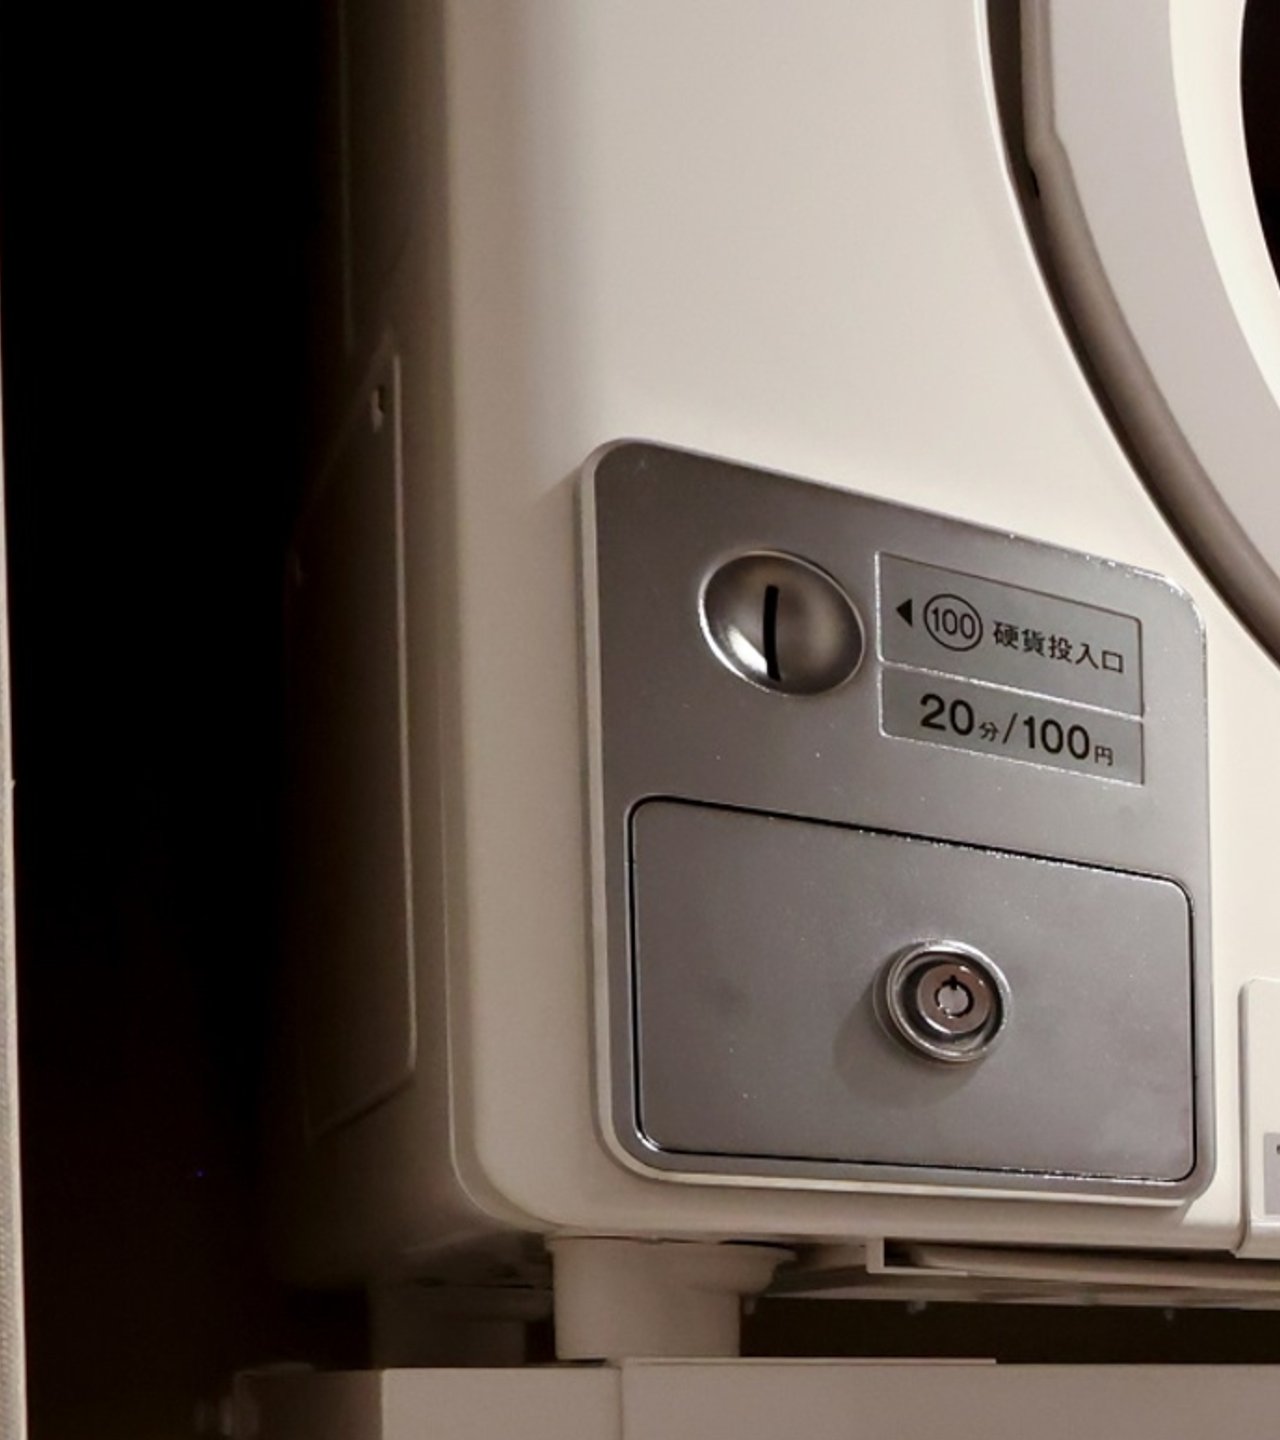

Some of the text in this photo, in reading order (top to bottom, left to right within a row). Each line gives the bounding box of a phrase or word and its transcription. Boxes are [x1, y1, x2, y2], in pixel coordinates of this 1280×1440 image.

[932, 606, 1124, 673] 100 硬貨投入口
[920, 693, 1114, 766] 20分/100円
